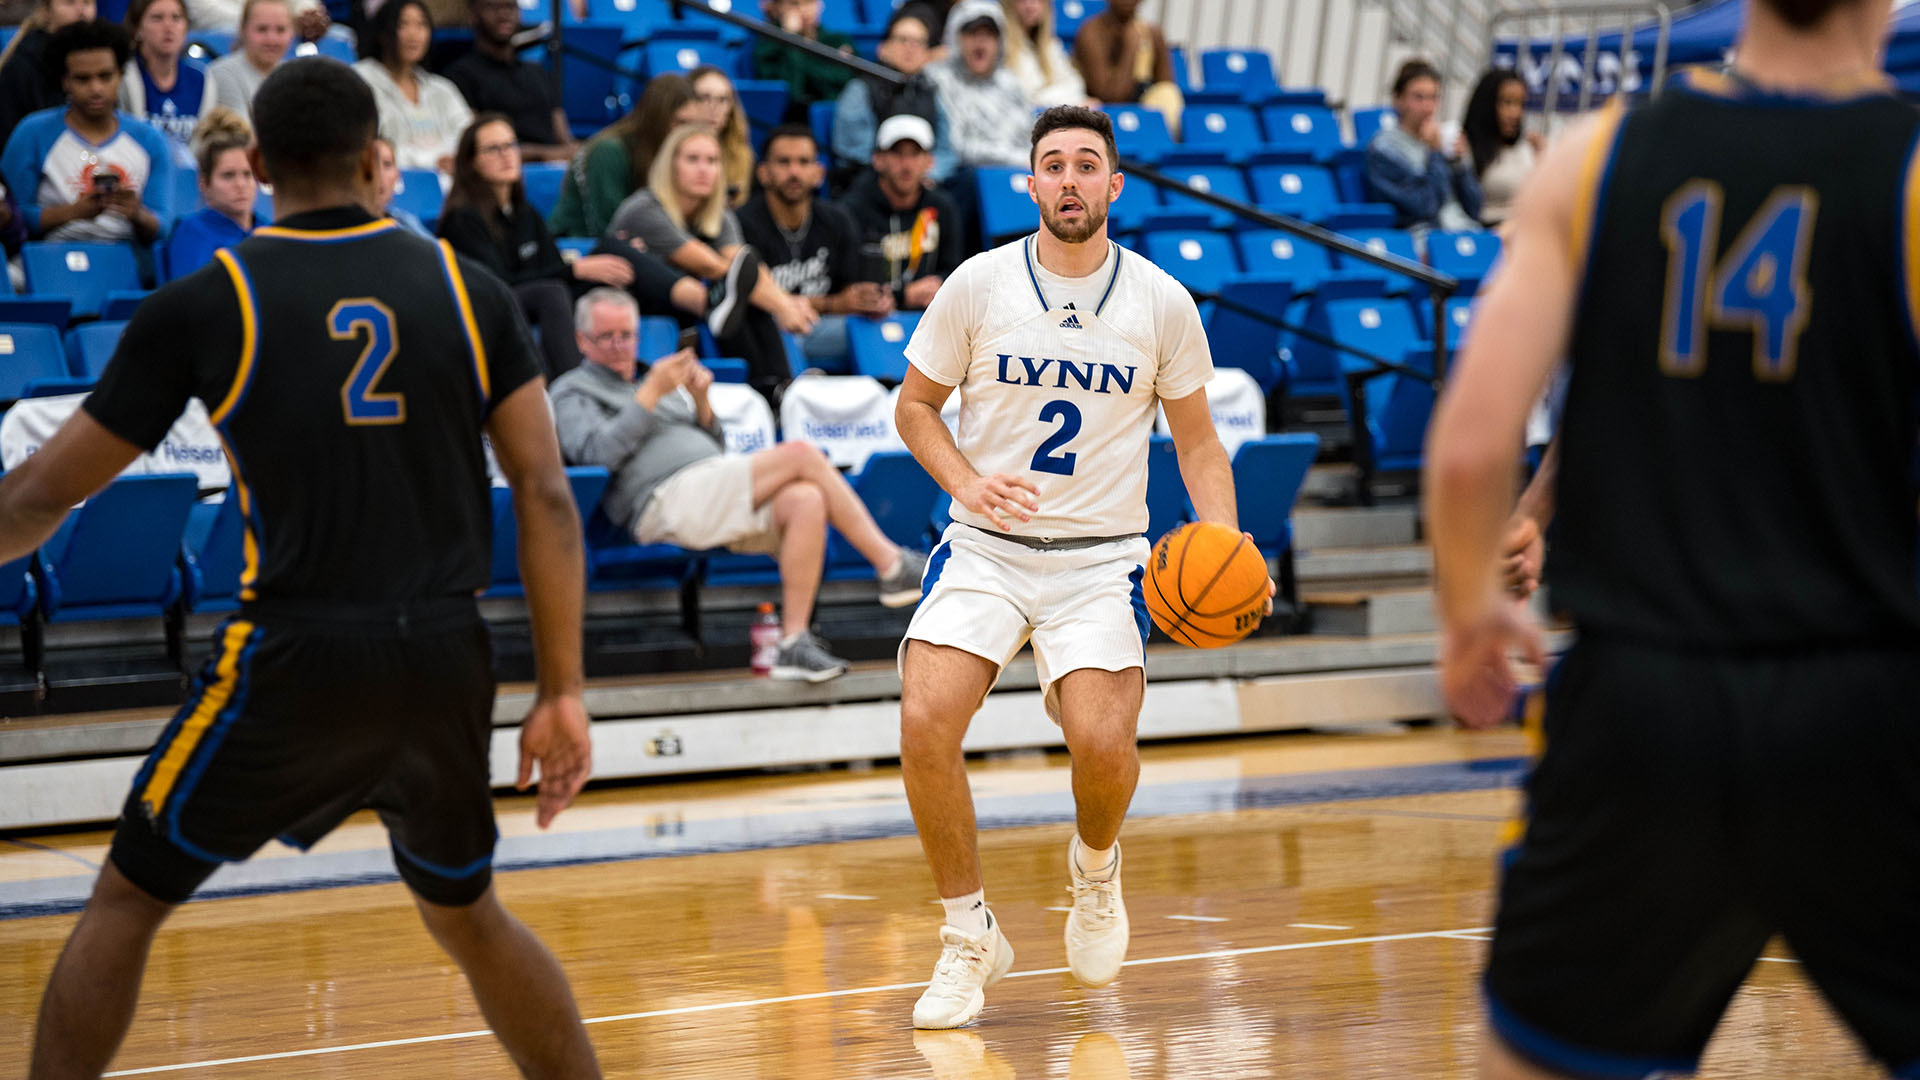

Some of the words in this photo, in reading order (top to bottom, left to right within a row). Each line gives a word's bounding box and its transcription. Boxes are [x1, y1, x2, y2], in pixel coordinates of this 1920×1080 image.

[1658, 176, 1821, 382] 14
[326, 297, 406, 425] 2
[996, 353, 1138, 394] LYNN
[163, 440, 223, 462] Reser
[1029, 399, 1083, 476] 2
